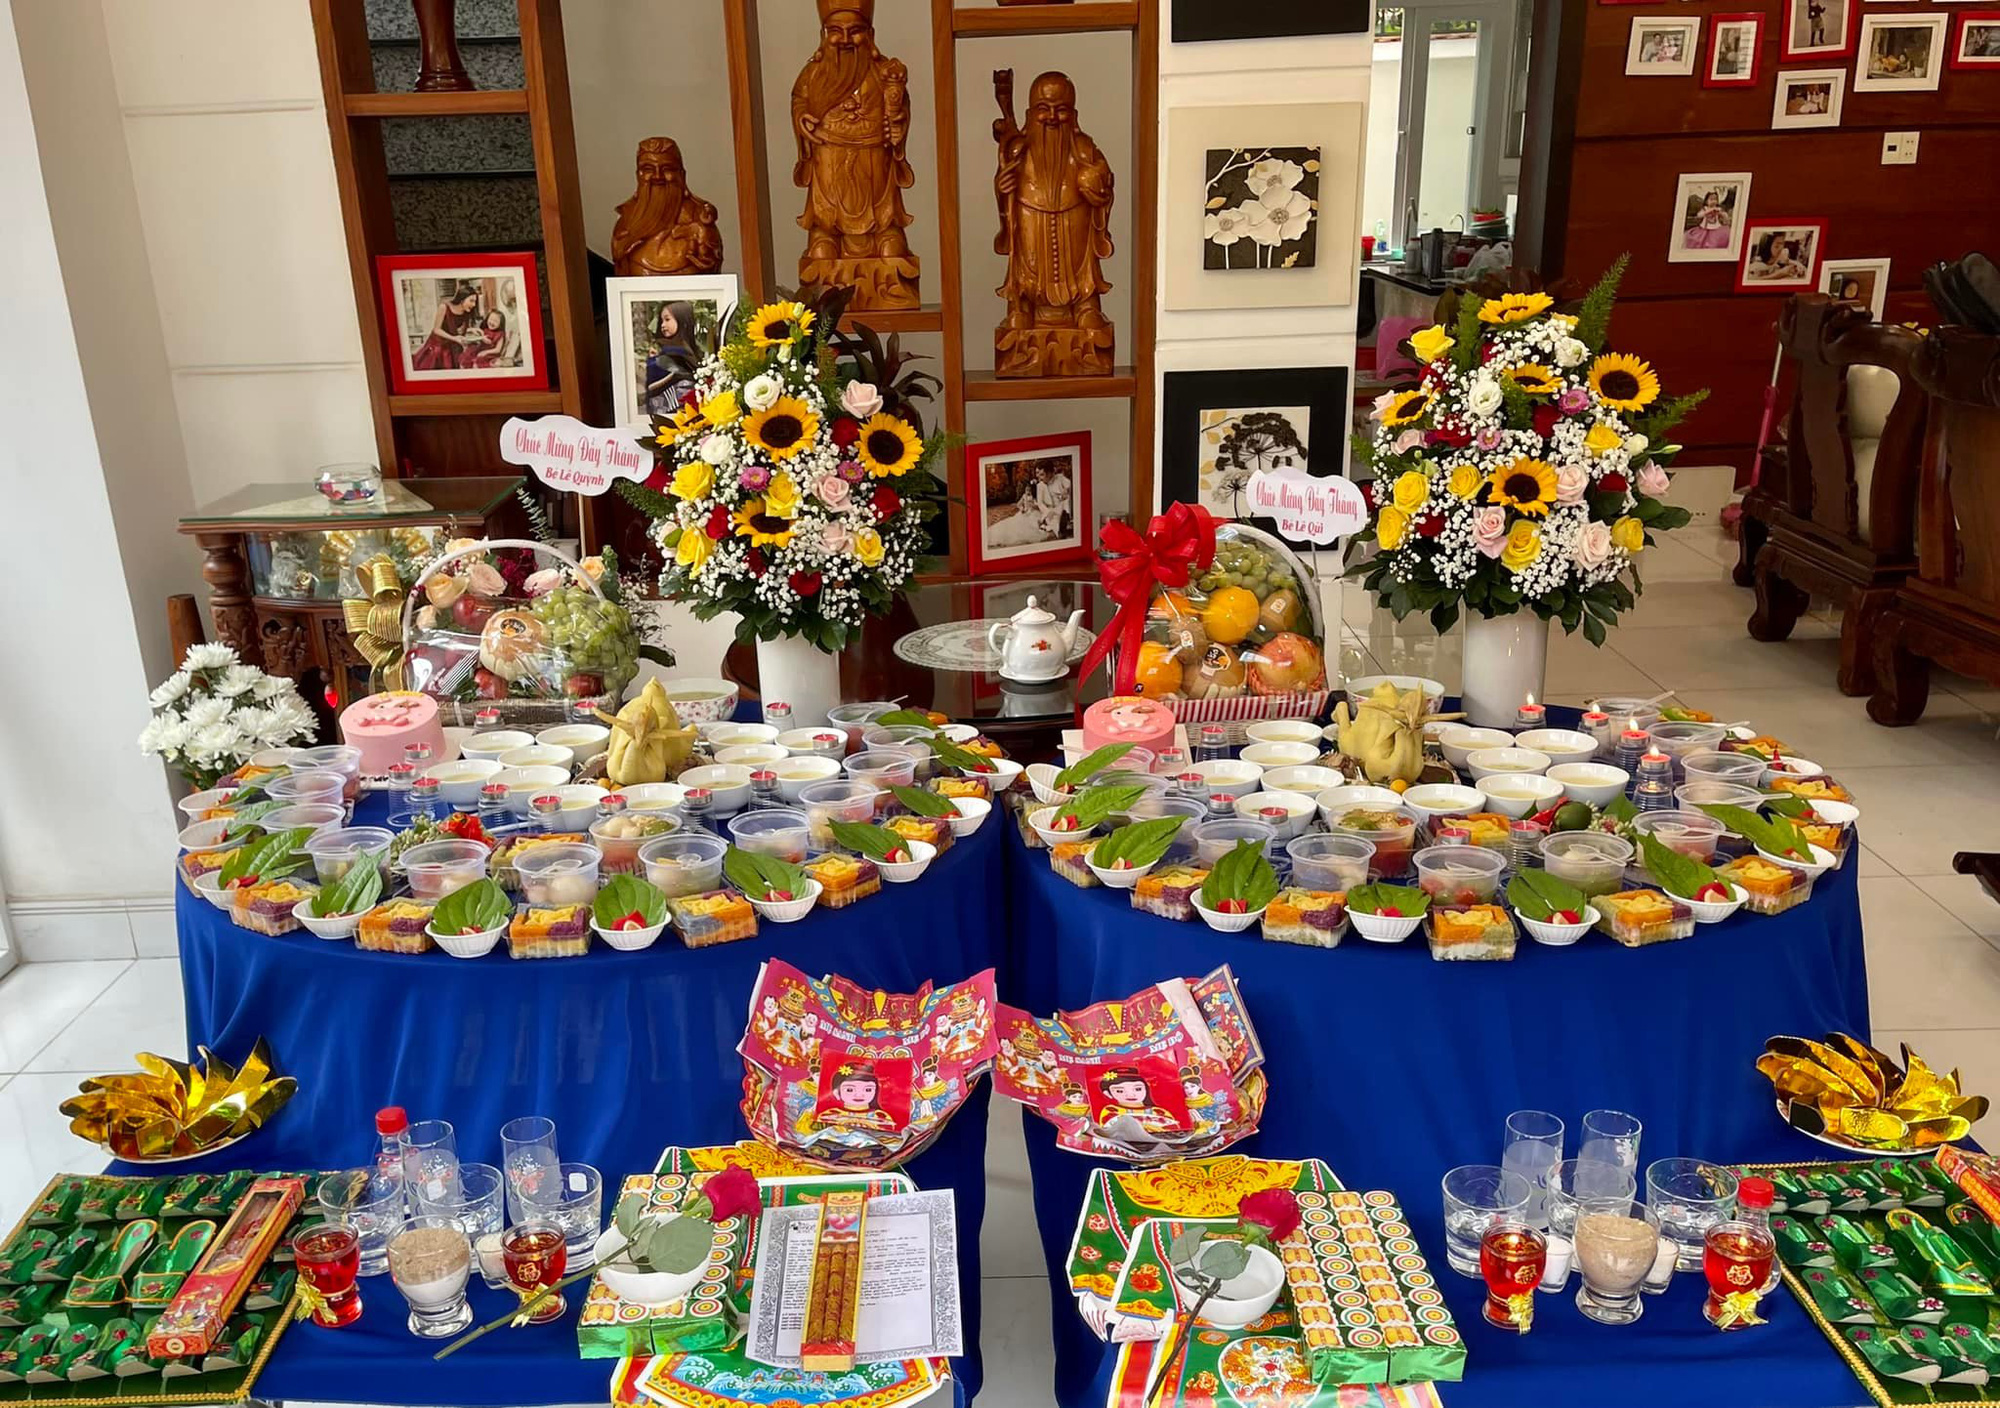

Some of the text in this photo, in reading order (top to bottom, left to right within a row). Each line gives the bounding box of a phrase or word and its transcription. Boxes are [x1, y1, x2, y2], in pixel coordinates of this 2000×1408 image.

[516, 427, 541, 454] Chúc
[545, 431, 575, 464] Mừng
[605, 438, 641, 474] Tháng
[545, 466, 558, 479] Bé
[1256, 480, 1275, 506] Chúc
[1278, 483, 1303, 515] Mừng
[1328, 488, 1358, 521] Tháng
[1282, 518, 1294, 531] Bé
